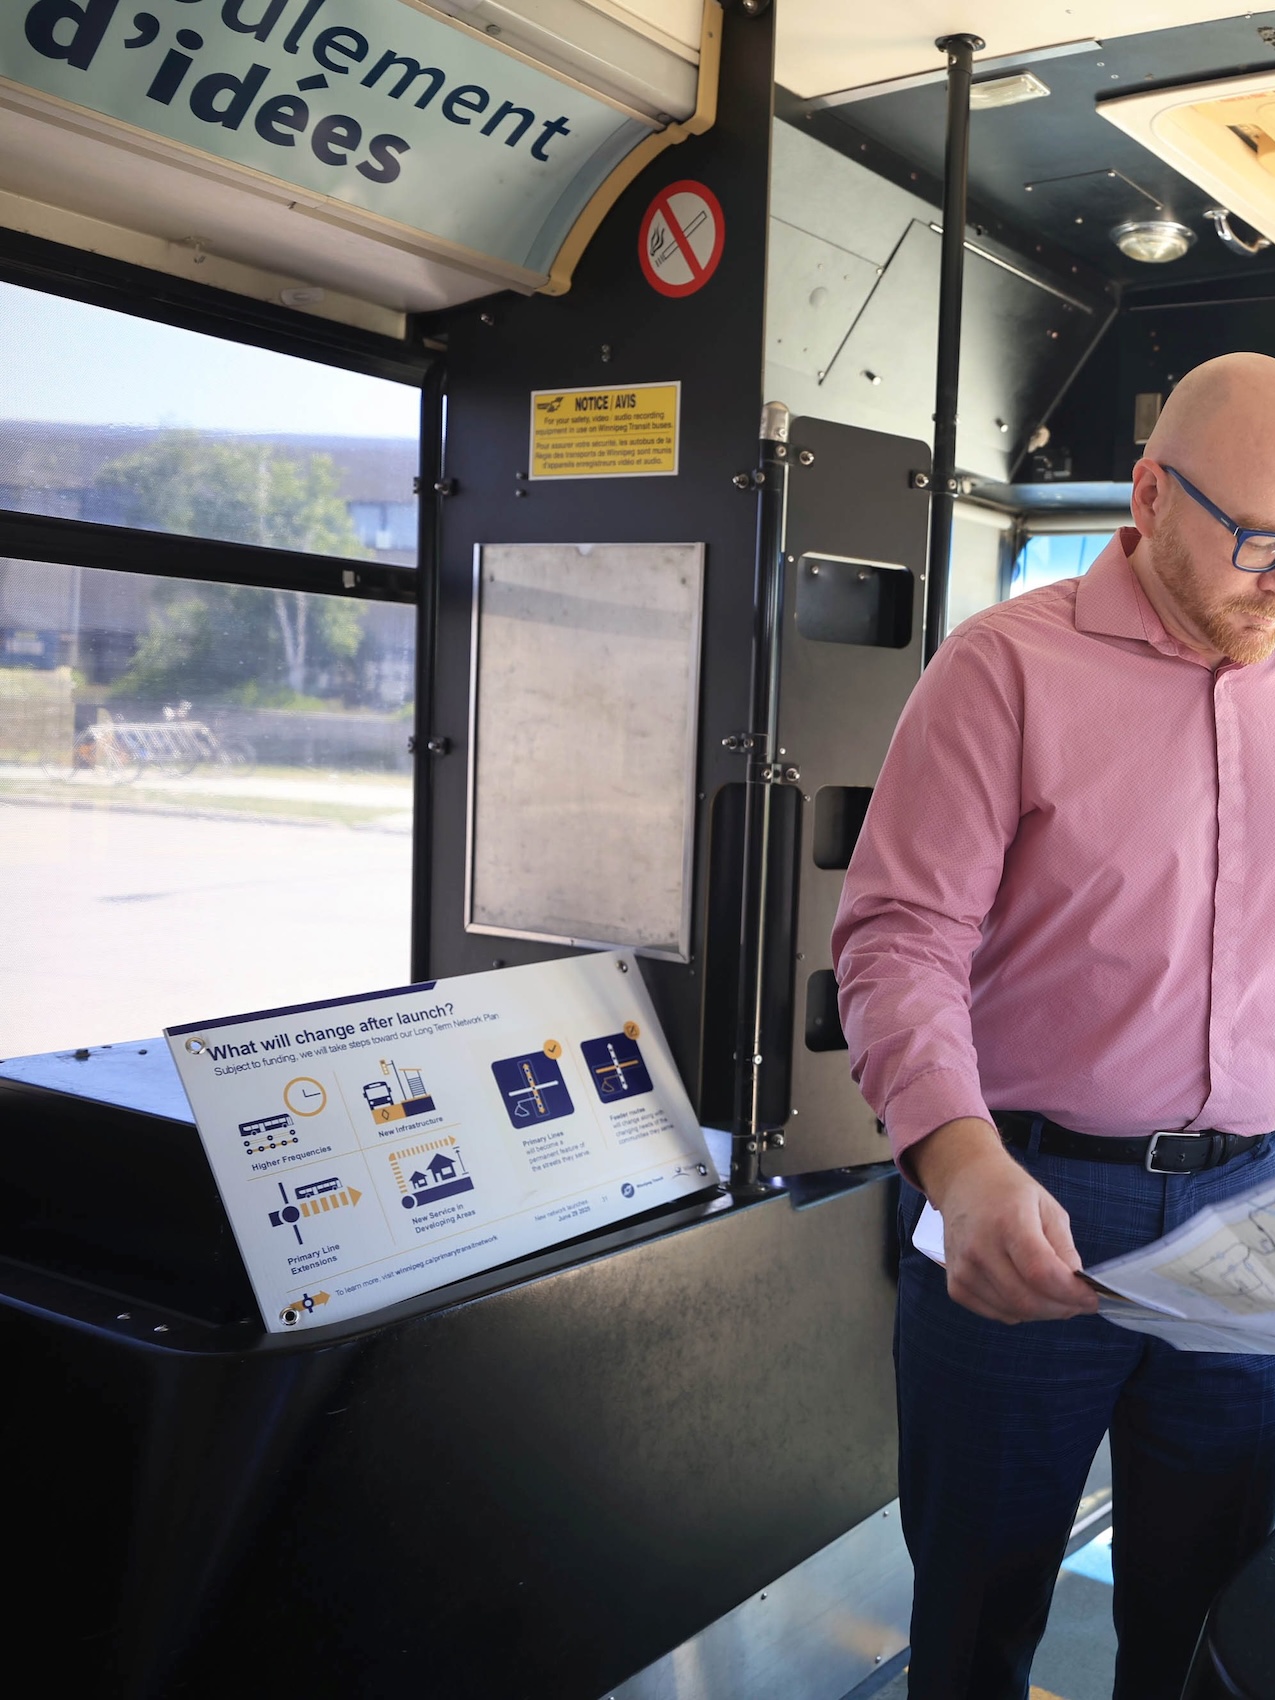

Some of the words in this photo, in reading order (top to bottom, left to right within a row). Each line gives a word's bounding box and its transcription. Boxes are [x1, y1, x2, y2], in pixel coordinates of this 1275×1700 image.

[175, 0, 570, 162] ulement
[24, 0, 411, 184] d'idées
[575, 396, 608, 411] NOTICE
[615, 394, 636, 408] AVIS
[544, 417, 555, 425] For
[571, 416, 590, 424] safety,
[614, 413, 632, 421] audio
[633, 412, 665, 420] recording
[206, 1041, 257, 1061] What
[260, 1034, 291, 1051] will
[296, 1025, 355, 1044] change
[360, 1017, 393, 1032] after
[397, 1003, 453, 1024] launch?
[214, 1063, 251, 1076] Subject
[251, 1061, 261, 1069] to
[262, 1054, 298, 1066] funding,
[314, 1046, 328, 1056] will
[328, 1044, 347, 1053] take
[349, 1039, 371, 1049] steps
[371, 1032, 399, 1044] toward
[400, 1030, 412, 1039] our
[413, 1027, 434, 1036] Long
[433, 1023, 453, 1031] Term
[453, 1016, 482, 1027] Network
[396, 1117, 443, 1133] Infrastructure
[522, 1137, 547, 1147] Primary
[547, 1132, 564, 1140] Lines
[536, 1142, 559, 1152] become
[252, 1159, 280, 1171] Higher
[282, 1146, 332, 1163] Frequencies
[412, 1216, 428, 1224] New
[429, 1207, 456, 1219] Service
[415, 1217, 455, 1234] Developing
[457, 1210, 476, 1220] Areas
[288, 1251, 320, 1265] Primary
[322, 1245, 340, 1254] Line
[344, 1284, 362, 1293] learn
[381, 1272, 395, 1280] visit
[395, 1236, 497, 1275] winnipeg.ca/primarytransitnetwork
[291, 1256, 337, 1275] Extensions
